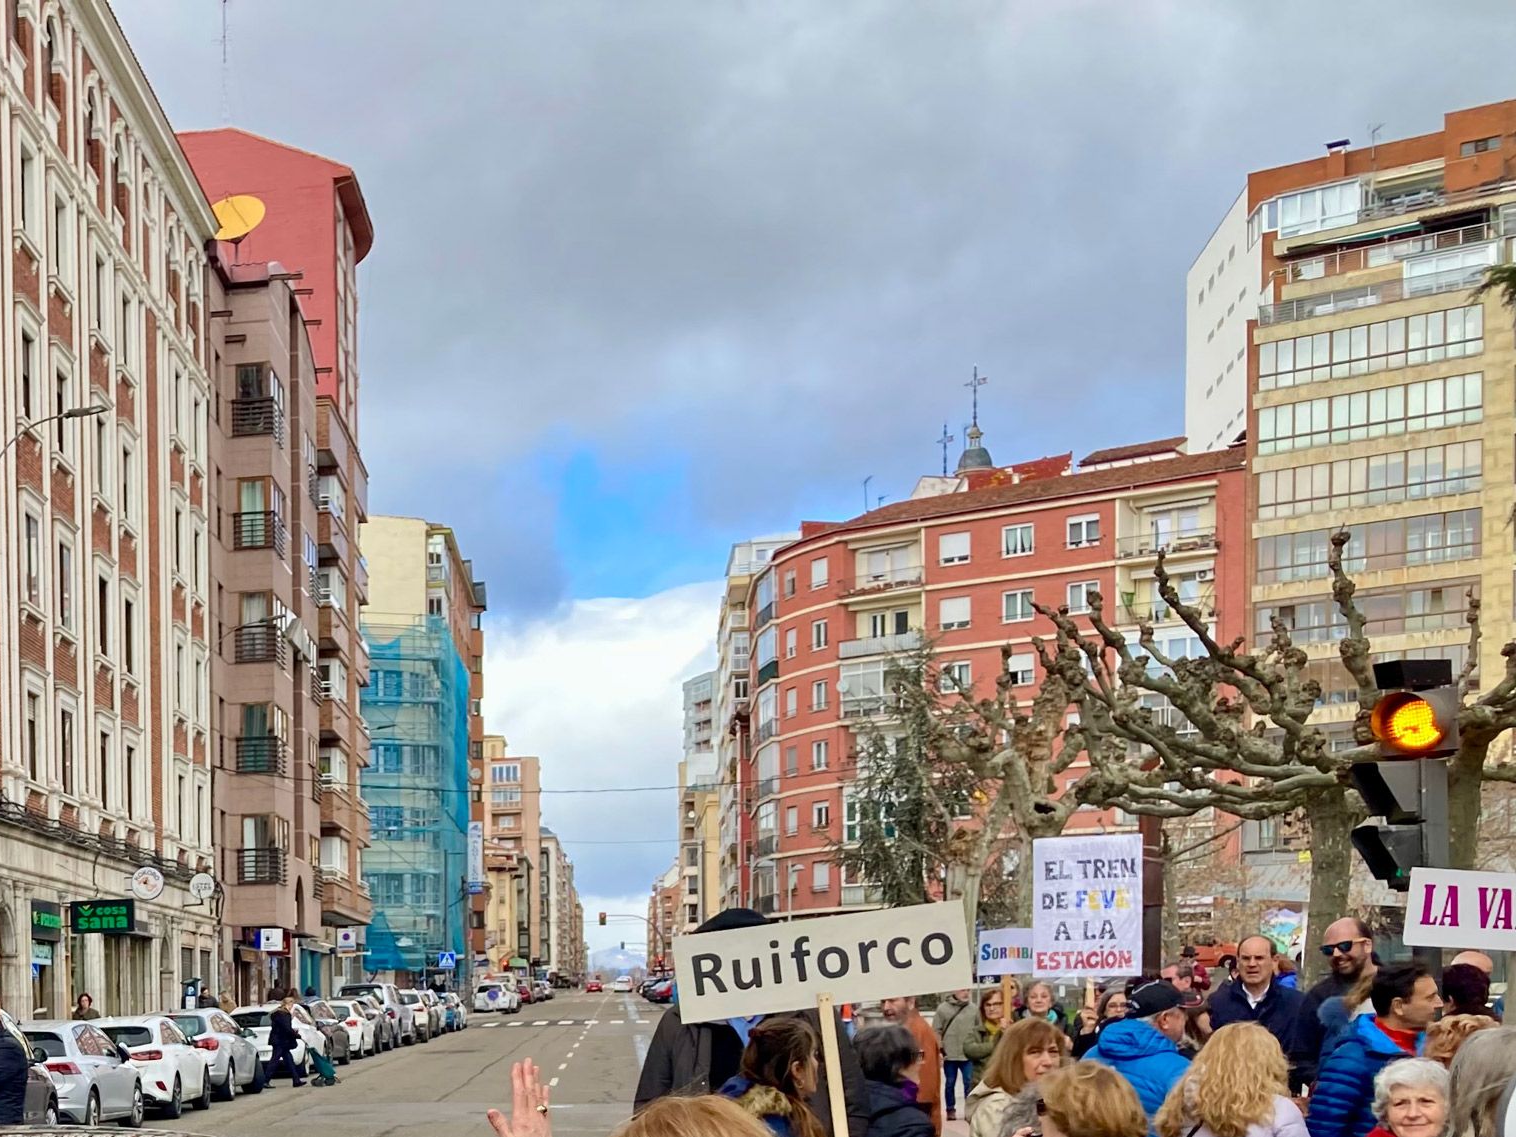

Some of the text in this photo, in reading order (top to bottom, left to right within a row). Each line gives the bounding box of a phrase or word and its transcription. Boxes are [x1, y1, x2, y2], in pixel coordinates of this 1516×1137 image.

[1044, 857, 1138, 880] EL TREN
[96, 905, 127, 915] cosa
[1042, 887, 1130, 911] DE FEVE
[1420, 884, 1516, 930] LA VA
[78, 915, 128, 929] sana
[1054, 919, 1117, 941] A LA
[691, 932, 953, 996] Ruiforco
[1036, 945, 1133, 971] ESTACIÓN
